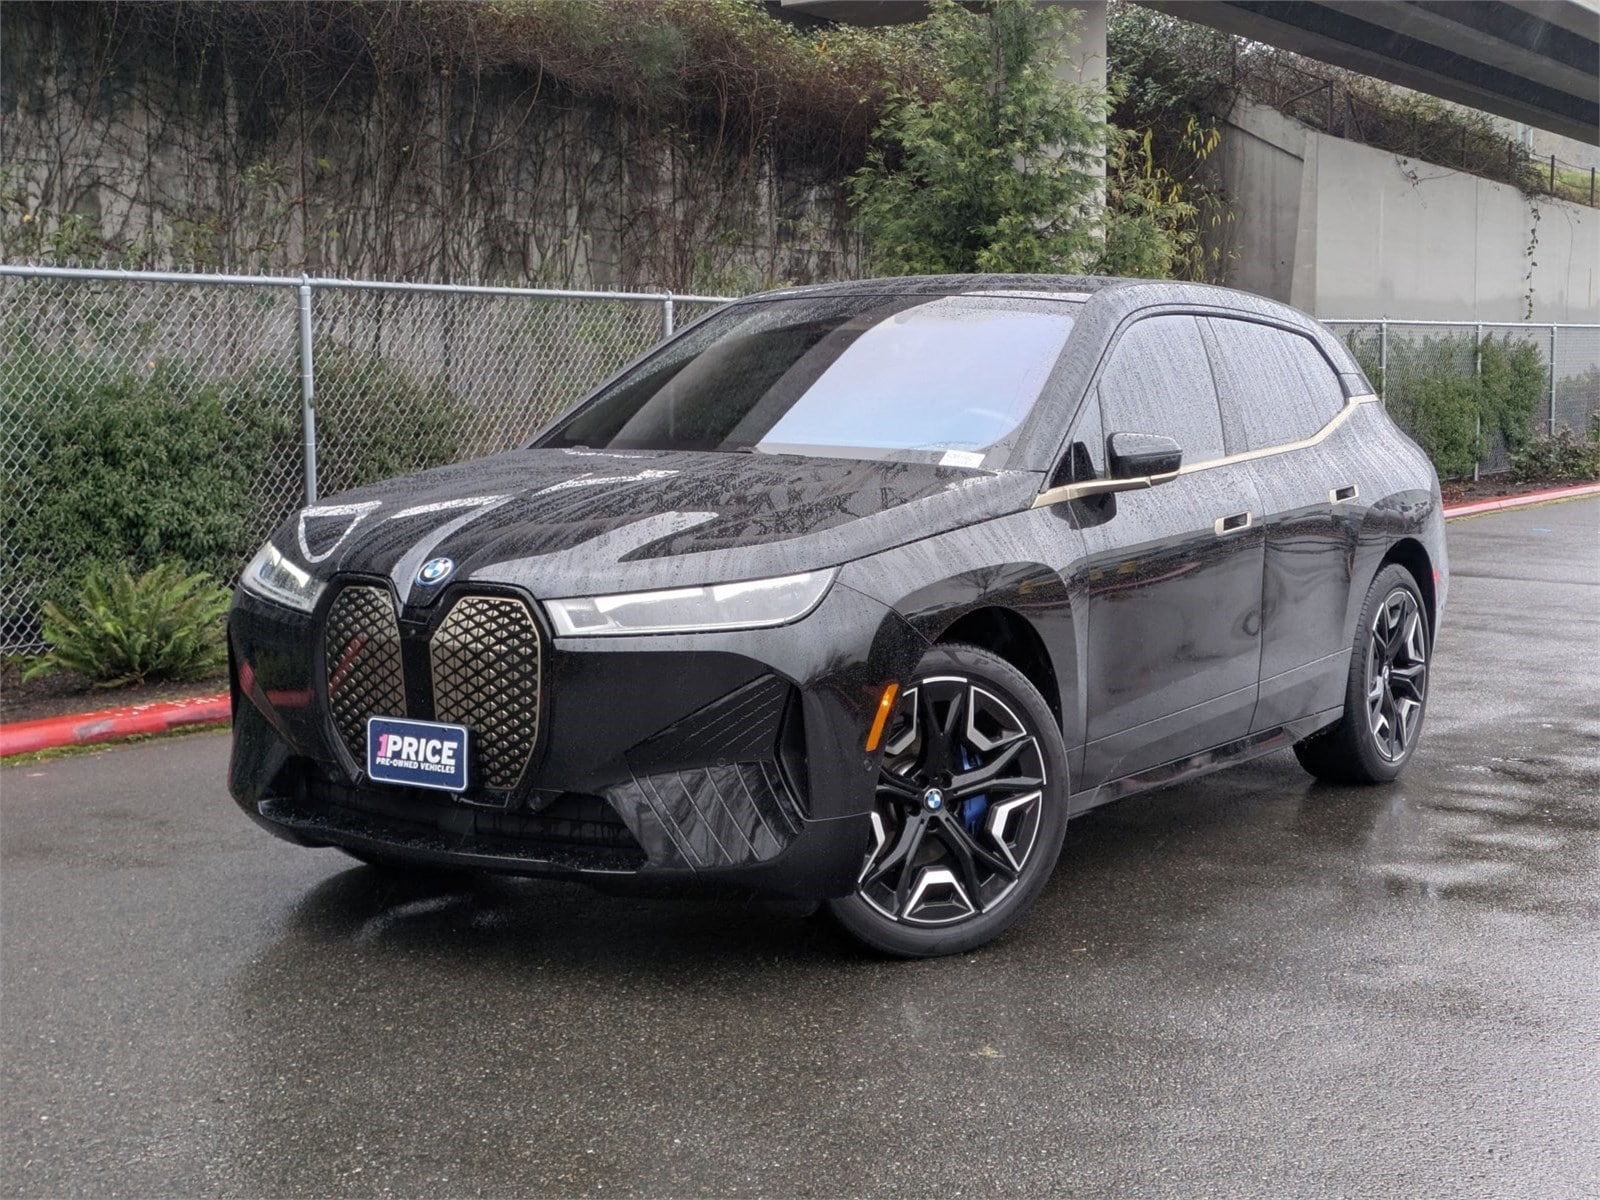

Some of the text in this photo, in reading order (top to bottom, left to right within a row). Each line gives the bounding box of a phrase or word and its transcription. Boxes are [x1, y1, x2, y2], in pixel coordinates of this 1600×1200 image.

[377, 734, 458, 765] 1PRICE
[376, 757, 455, 774] PRE-OWNED VEHICLES
